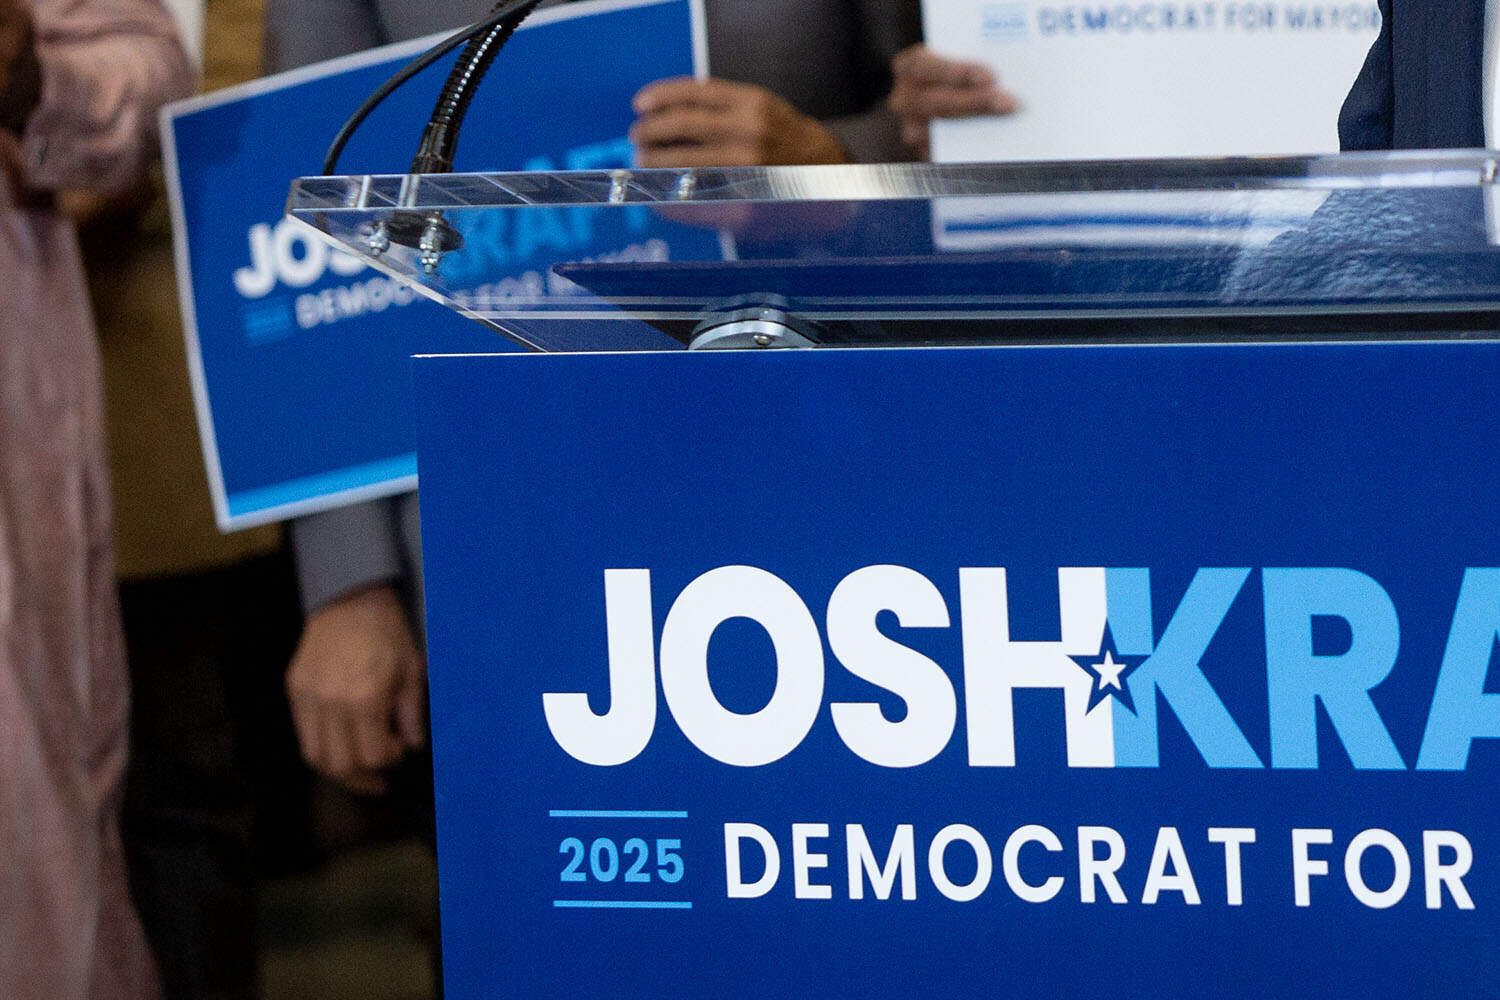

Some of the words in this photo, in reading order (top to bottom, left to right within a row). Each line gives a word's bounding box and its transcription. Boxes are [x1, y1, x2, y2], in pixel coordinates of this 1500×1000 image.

[1037, 1, 1216, 36] DEMOCRAT
[1223, 2, 1275, 34] FOR
[559, 838, 686, 884] 2025
[724, 822, 1256, 906] DEMOCRAT
[1292, 828, 1475, 910] FOR
